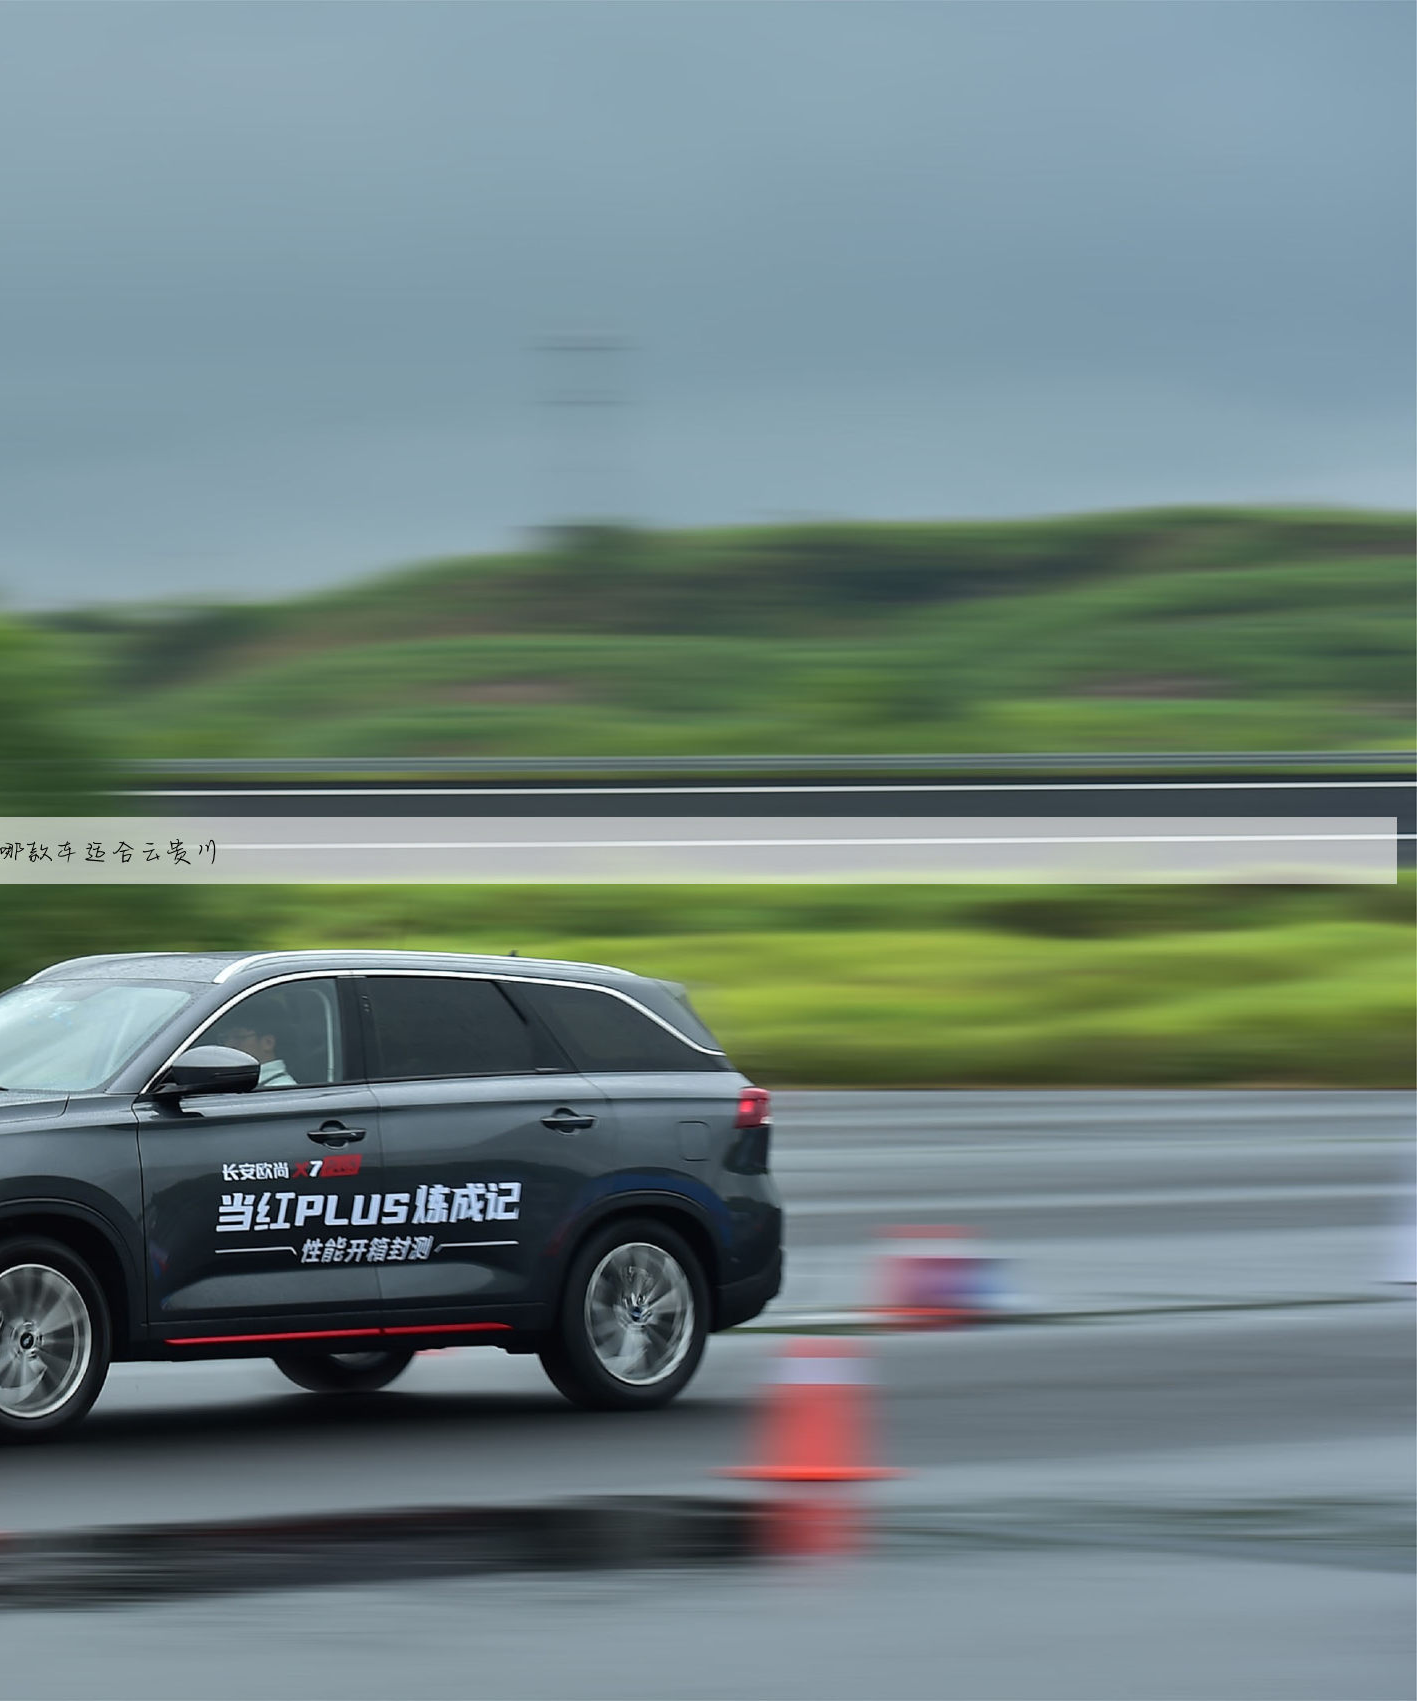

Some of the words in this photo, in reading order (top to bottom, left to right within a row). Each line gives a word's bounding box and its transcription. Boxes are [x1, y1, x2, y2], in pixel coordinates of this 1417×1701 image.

[300, 1235, 433, 1263] 性能开箱封测
